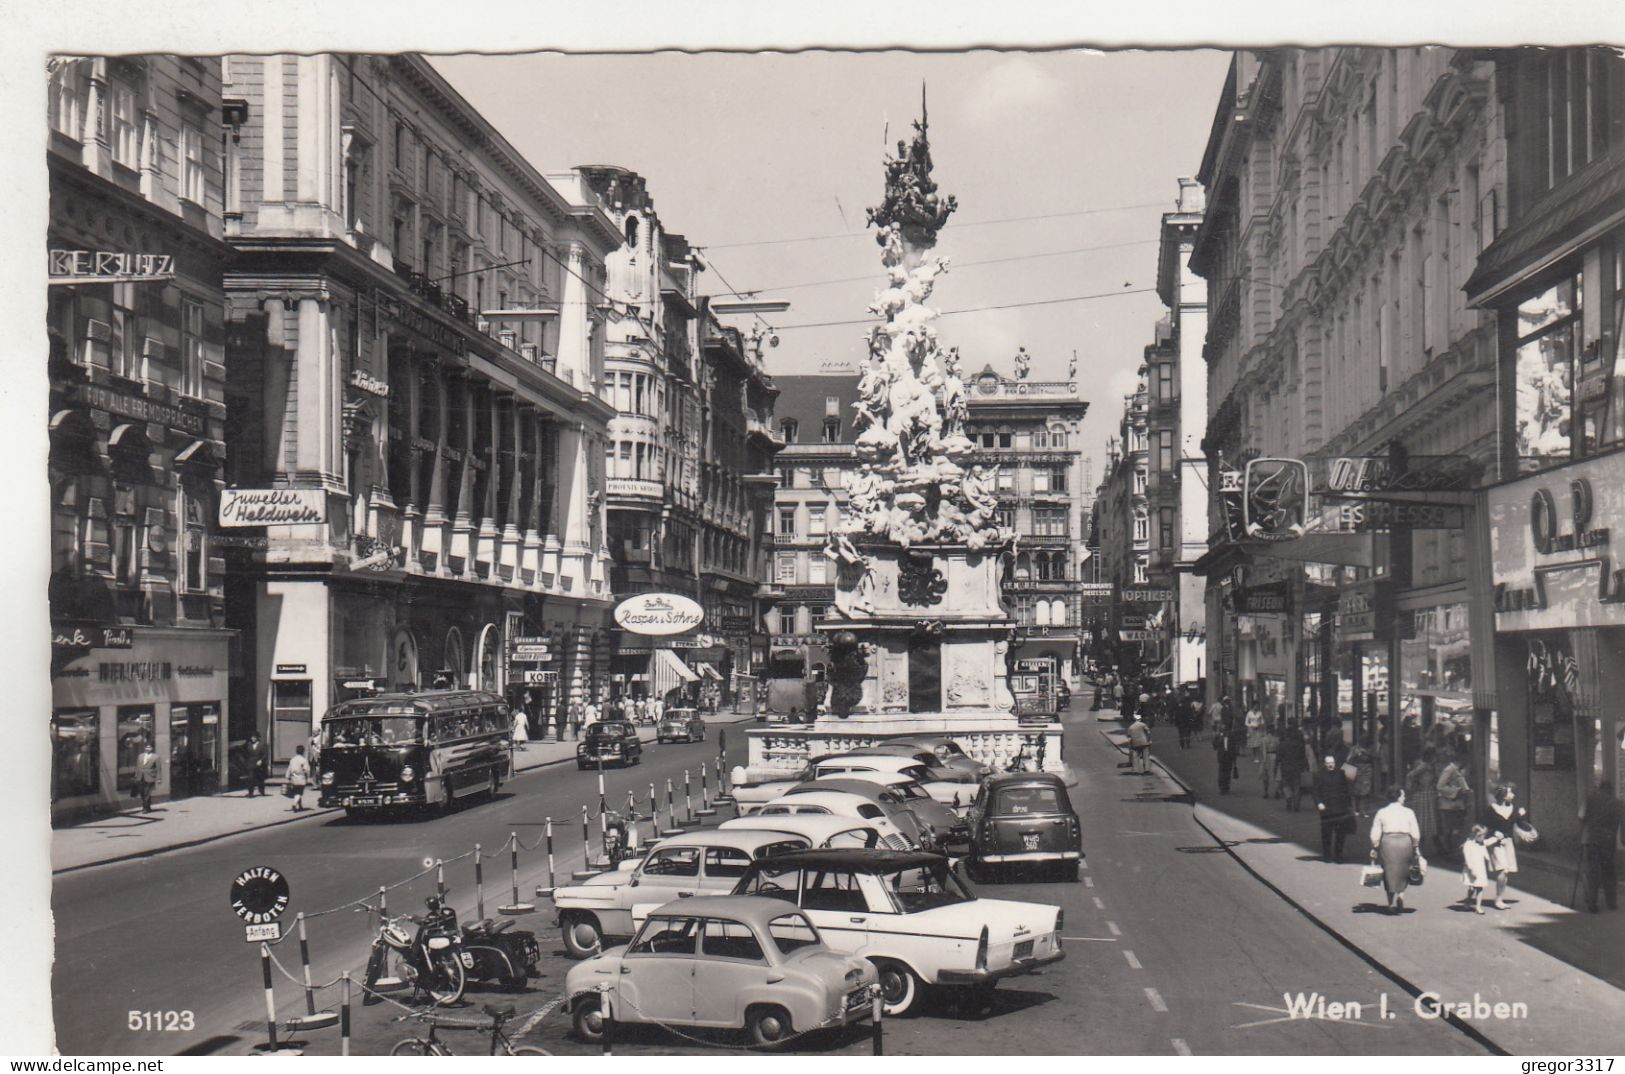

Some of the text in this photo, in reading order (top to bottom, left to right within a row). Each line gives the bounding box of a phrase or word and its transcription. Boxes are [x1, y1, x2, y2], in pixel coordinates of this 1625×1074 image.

[49, 249, 171, 276] BERLITZ
[236, 506, 322, 522] Heldwein
[1341, 505, 1445, 523] ESPRESSO
[666, 611, 700, 624] Söhne
[236, 867, 279, 886] HALTEN
[232, 895, 288, 923] VERBOTEN
[249, 926, 276, 938] Anfang
